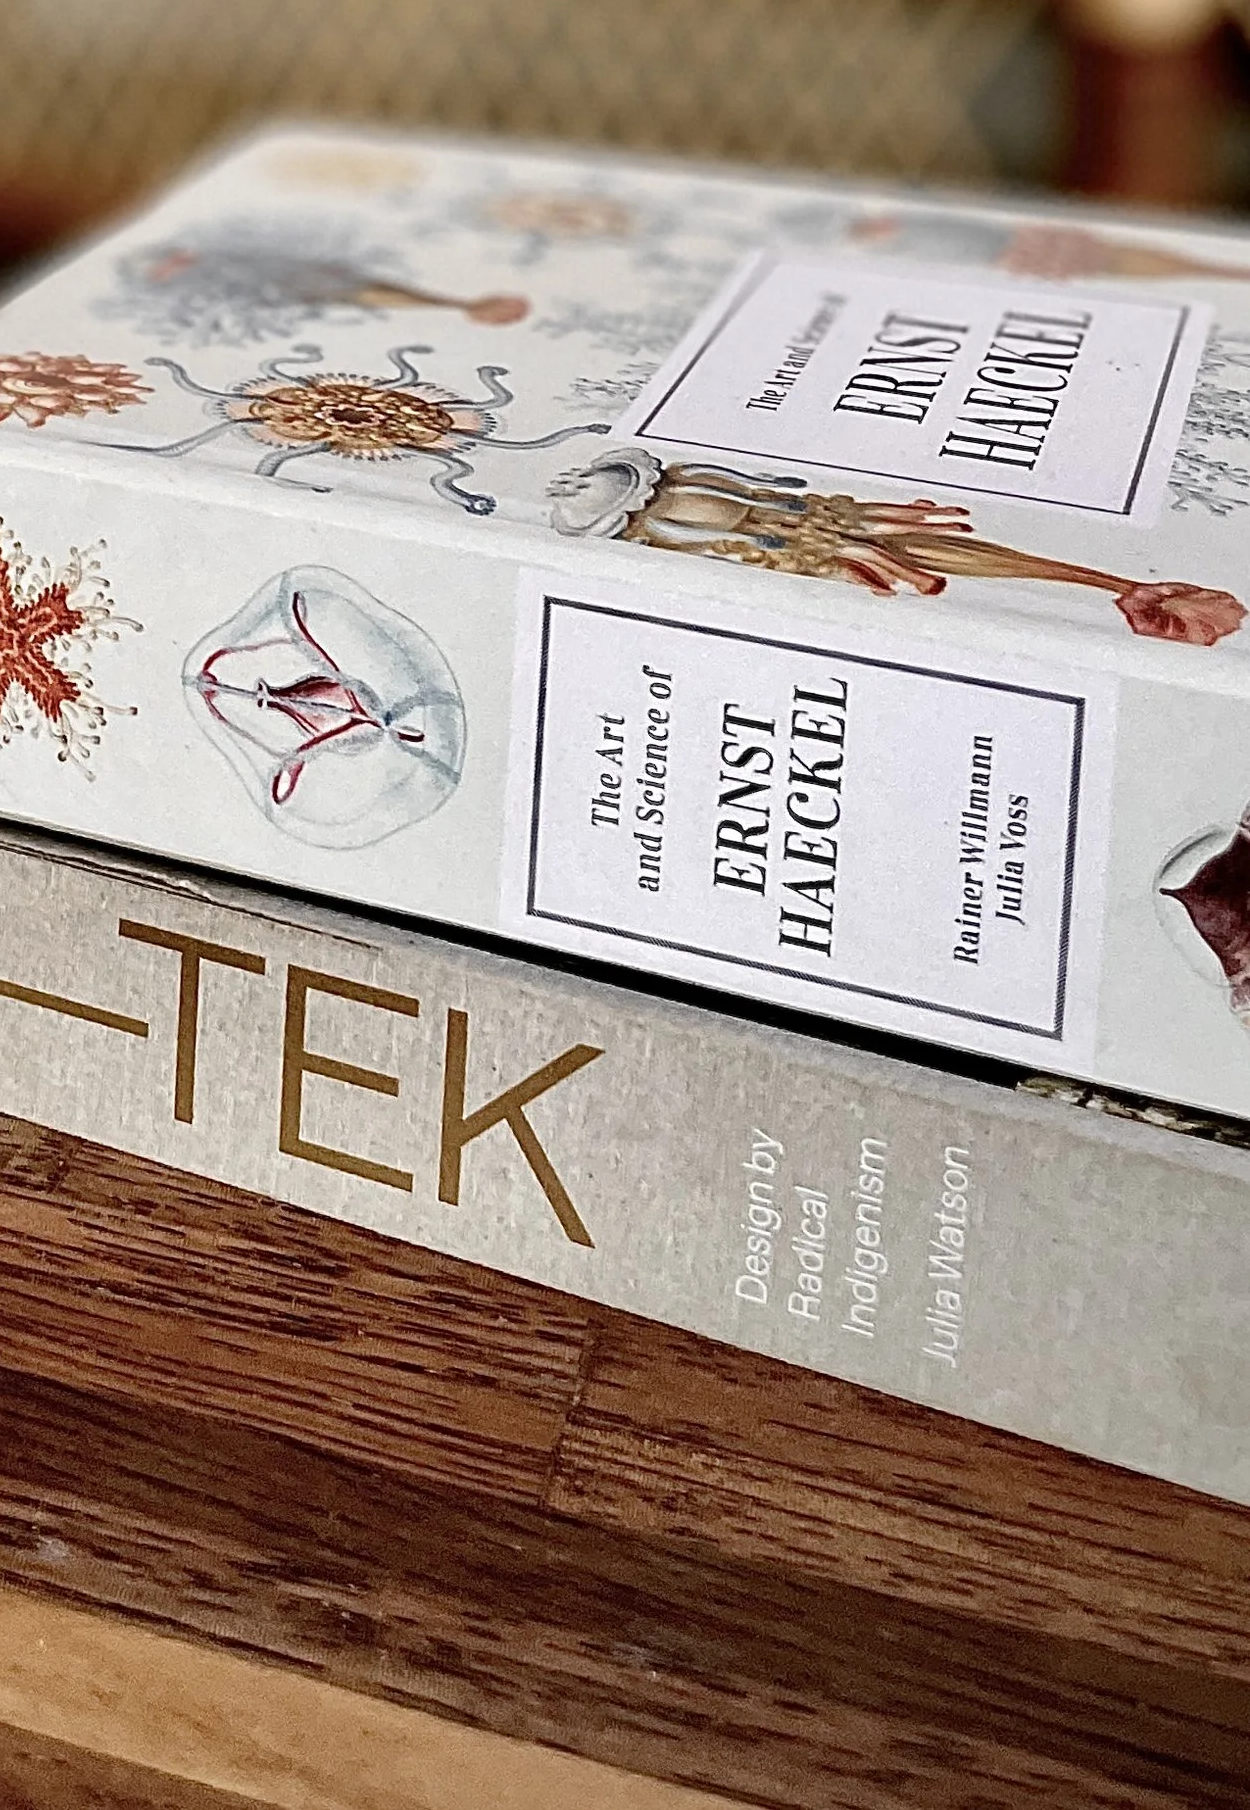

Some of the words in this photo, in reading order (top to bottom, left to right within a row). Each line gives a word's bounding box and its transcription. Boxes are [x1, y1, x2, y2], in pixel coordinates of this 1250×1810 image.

[745, 389, 787, 411] The
[763, 369, 801, 390] Art
[782, 344, 816, 369] and
[833, 310, 970, 425] ERNST
[939, 309, 1093, 471] HAECKEL
[642, 664, 673, 700] of
[595, 713, 625, 767] Art
[635, 707, 670, 826] Science
[590, 772, 622, 826] The
[713, 702, 776, 897] ERNST
[778, 677, 848, 958] HAECKEL
[959, 735, 993, 865] Willmann
[999, 793, 1029, 850] Voss
[633, 831, 663, 892] and
[995, 860, 1026, 926] Julia
[953, 871, 984, 965] Rainer
[741, 1128, 784, 1175] by
[735, 1181, 782, 1305] Design
[787, 1185, 829, 1321] Radical
[841, 1137, 889, 1338] Indigenism
[928, 1146, 970, 1280] Watson
[921, 1288, 962, 1368] Julia
